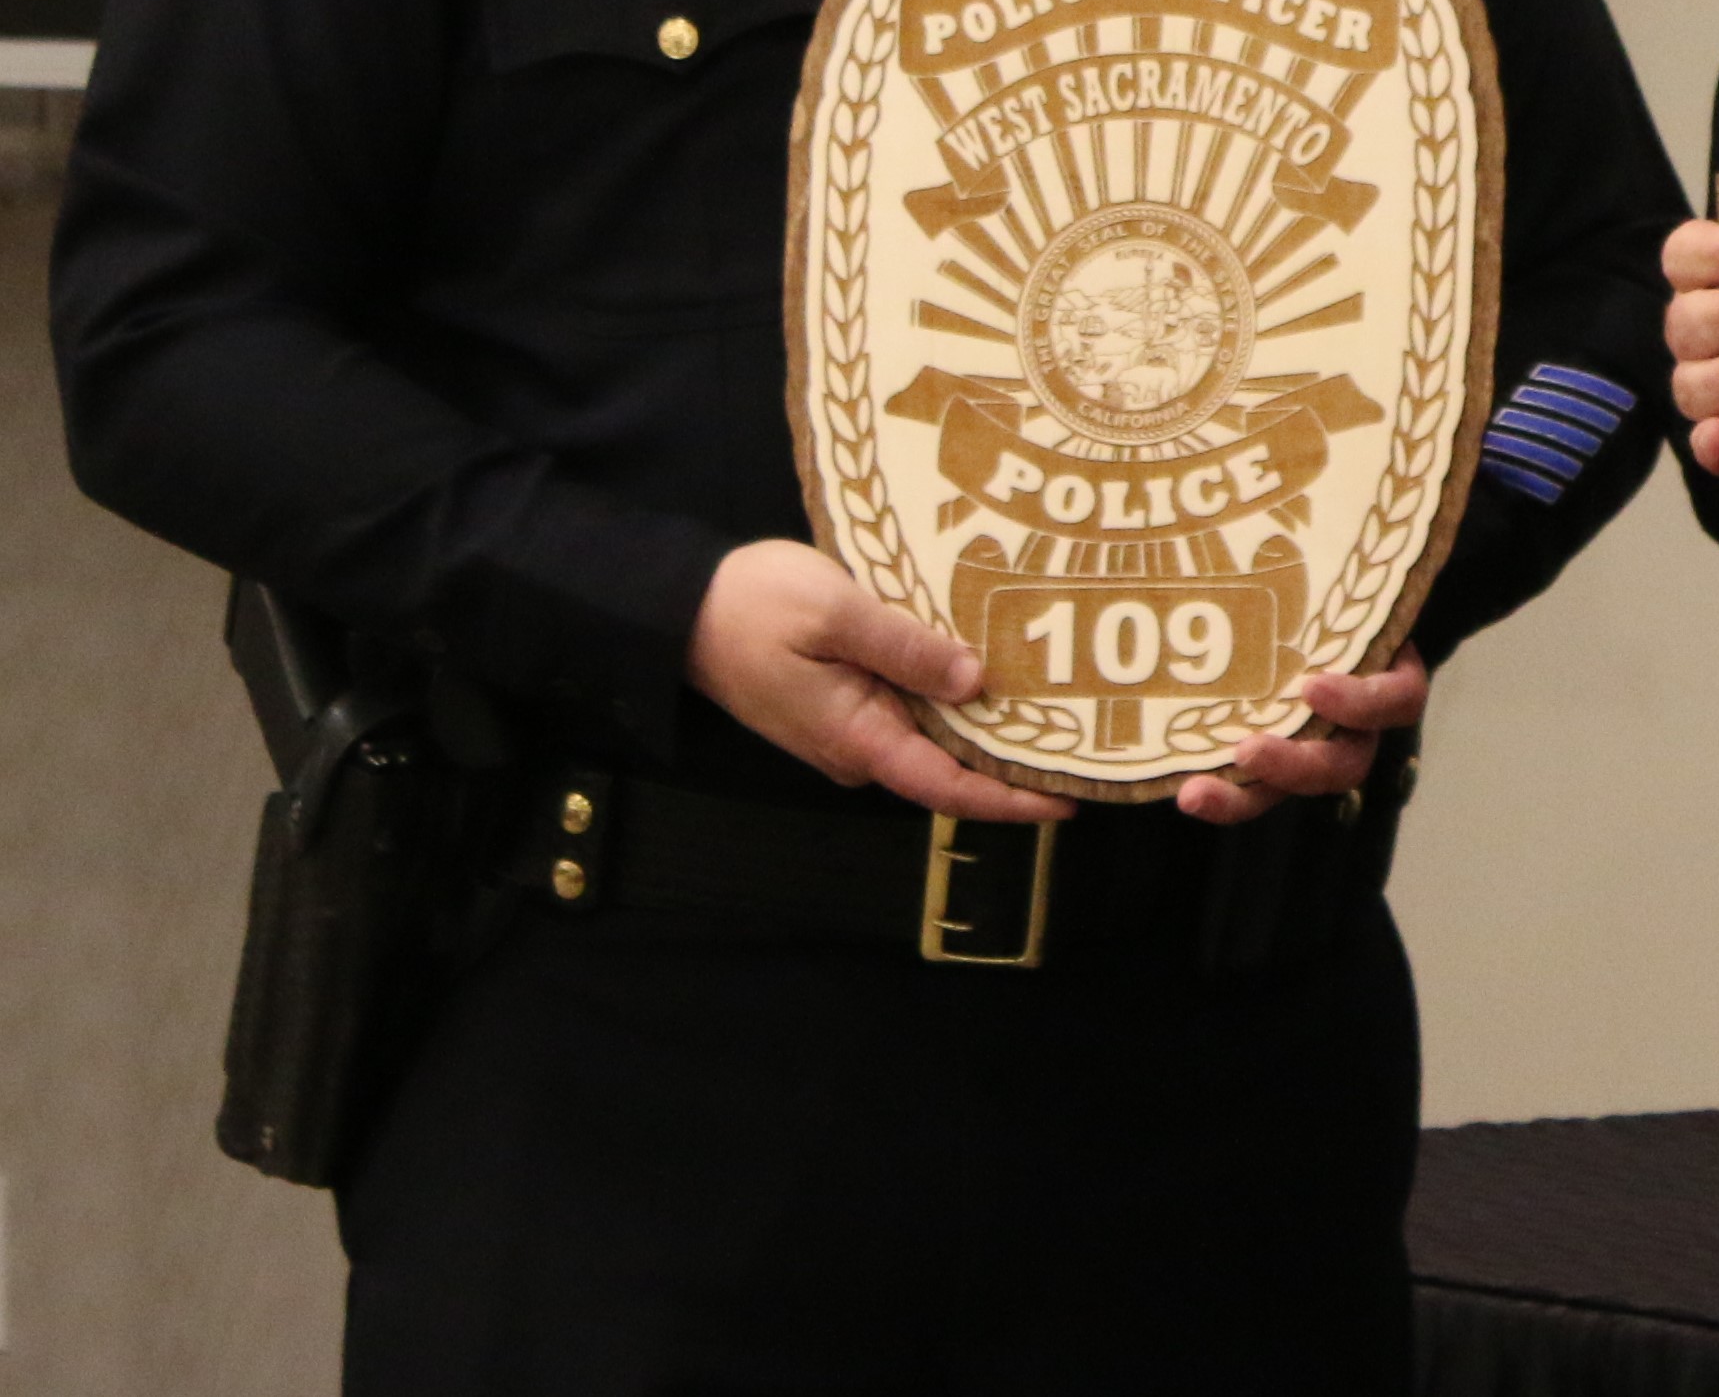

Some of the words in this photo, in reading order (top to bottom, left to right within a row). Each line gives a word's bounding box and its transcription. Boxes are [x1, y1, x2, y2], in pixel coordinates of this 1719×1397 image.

[945, 88, 1053, 172] WEST
[1059, 59, 1332, 166] SACRAMENTO
[1079, 225, 1128, 252] SEAL
[1141, 221, 1167, 237] OF
[1077, 401, 1190, 428] CALIFORNIA
[983, 445, 1282, 530] POLICE
[1026, 600, 1233, 685] 109
